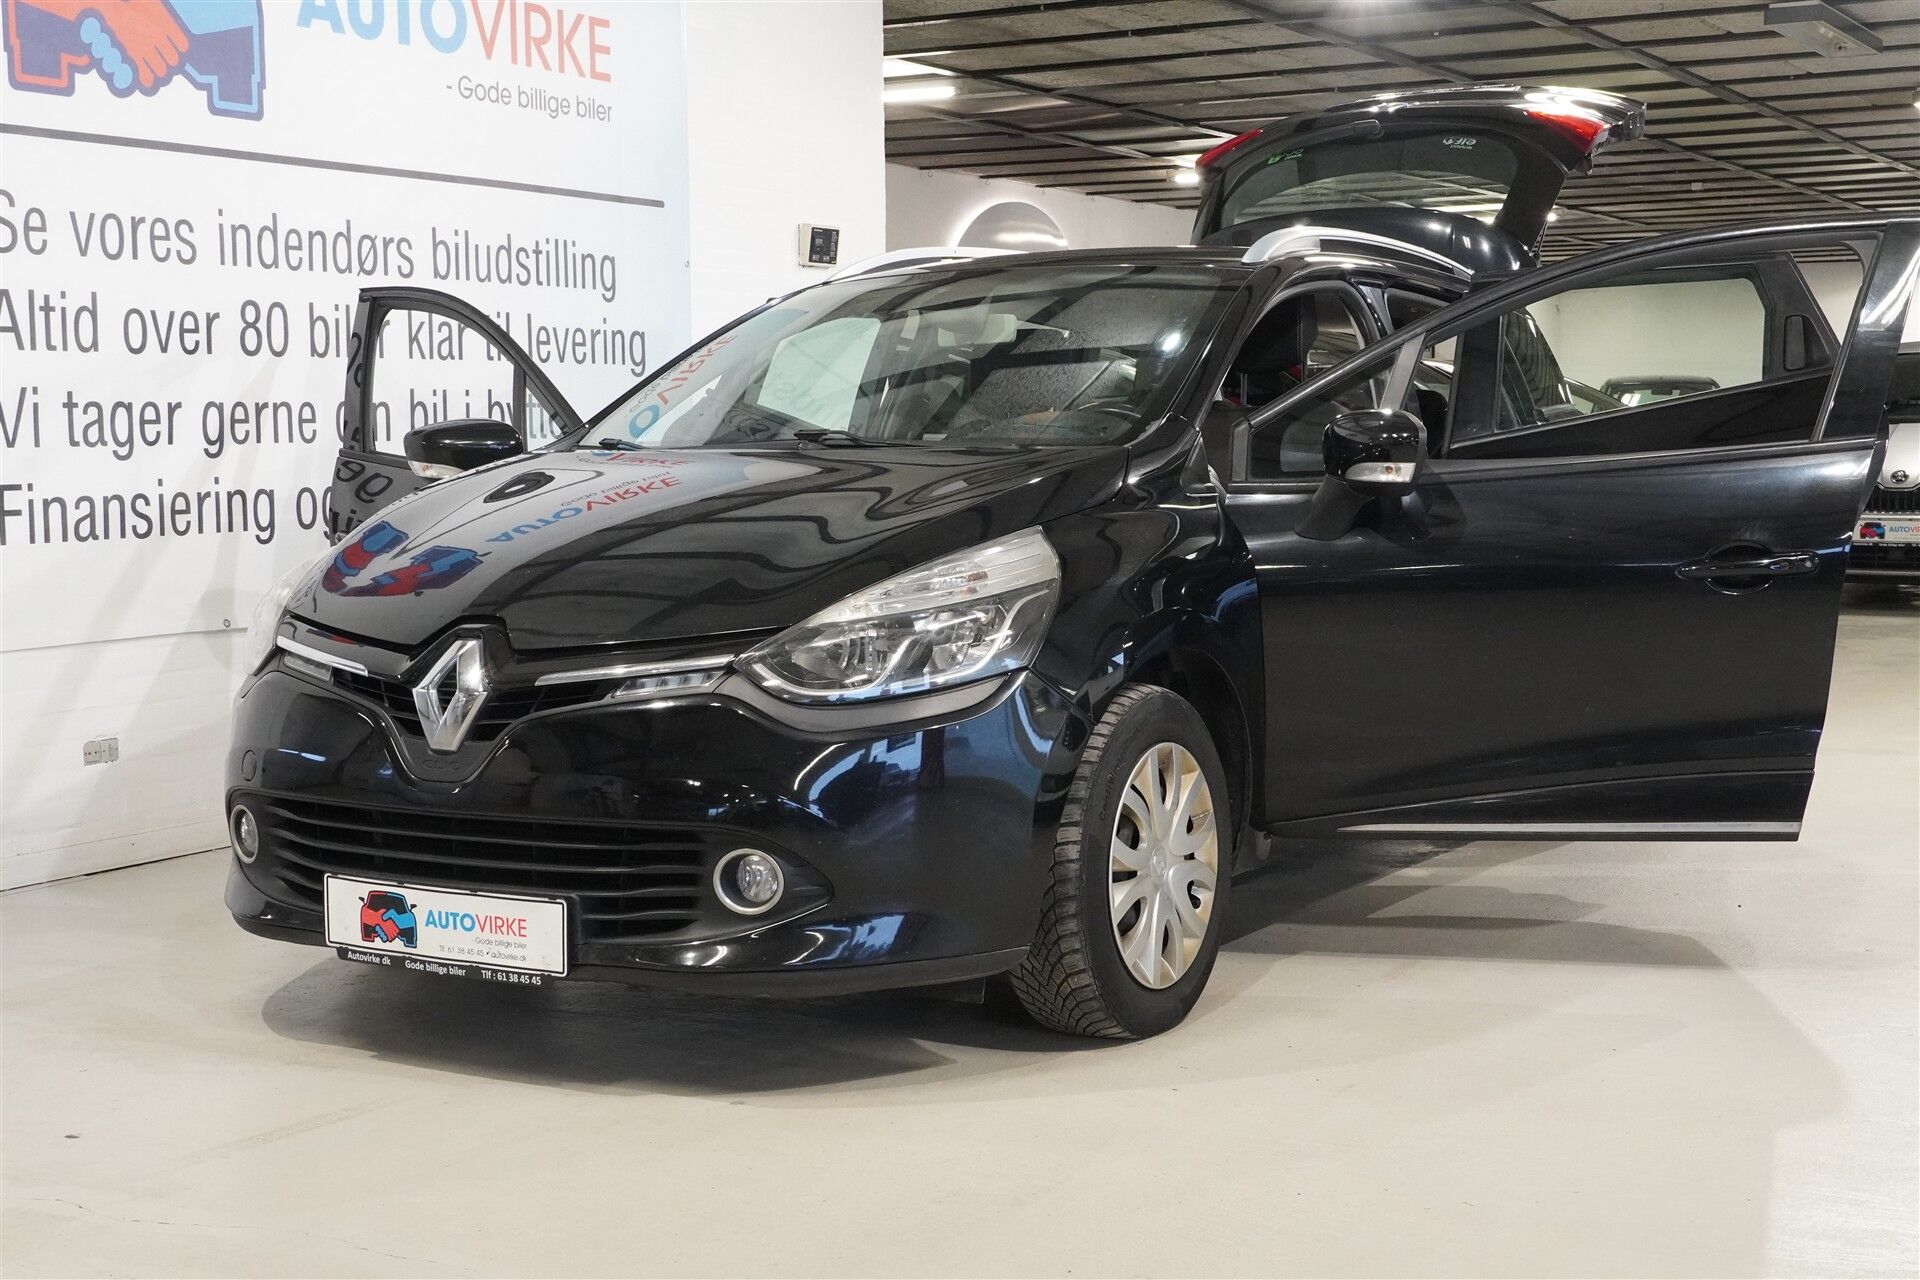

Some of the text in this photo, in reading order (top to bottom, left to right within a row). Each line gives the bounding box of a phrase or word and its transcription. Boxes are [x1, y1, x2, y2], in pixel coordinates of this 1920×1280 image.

[458, 75, 511, 105] Gode
[518, 85, 570, 119] billige
[577, 98, 612, 122] biler
[69, 211, 197, 265] vores
[218, 208, 415, 278] indendørs
[432, 226, 616, 303] biludstilling
[0, 288, 99, 353] Altid
[124, 307, 220, 355] over
[239, 300, 288, 358] 80
[308, 302, 391, 359] bilr
[527, 313, 646, 377] levering
[0, 386, 40, 448] Vi
[62, 391, 182, 461] tager
[202, 400, 317, 459] gerne
[0, 476, 275, 546] Finansiering
[425, 909, 527, 938] AUTOVIRKE
[475, 936, 493, 945] Gode
[405, 960, 424, 970] Gode
[426, 962, 447, 975] billige
[449, 965, 466, 976] biler
[497, 972, 507, 981] 61
[508, 973, 518, 982] 38
[520, 975, 530, 984] 45
[531, 976, 541, 985] 45
